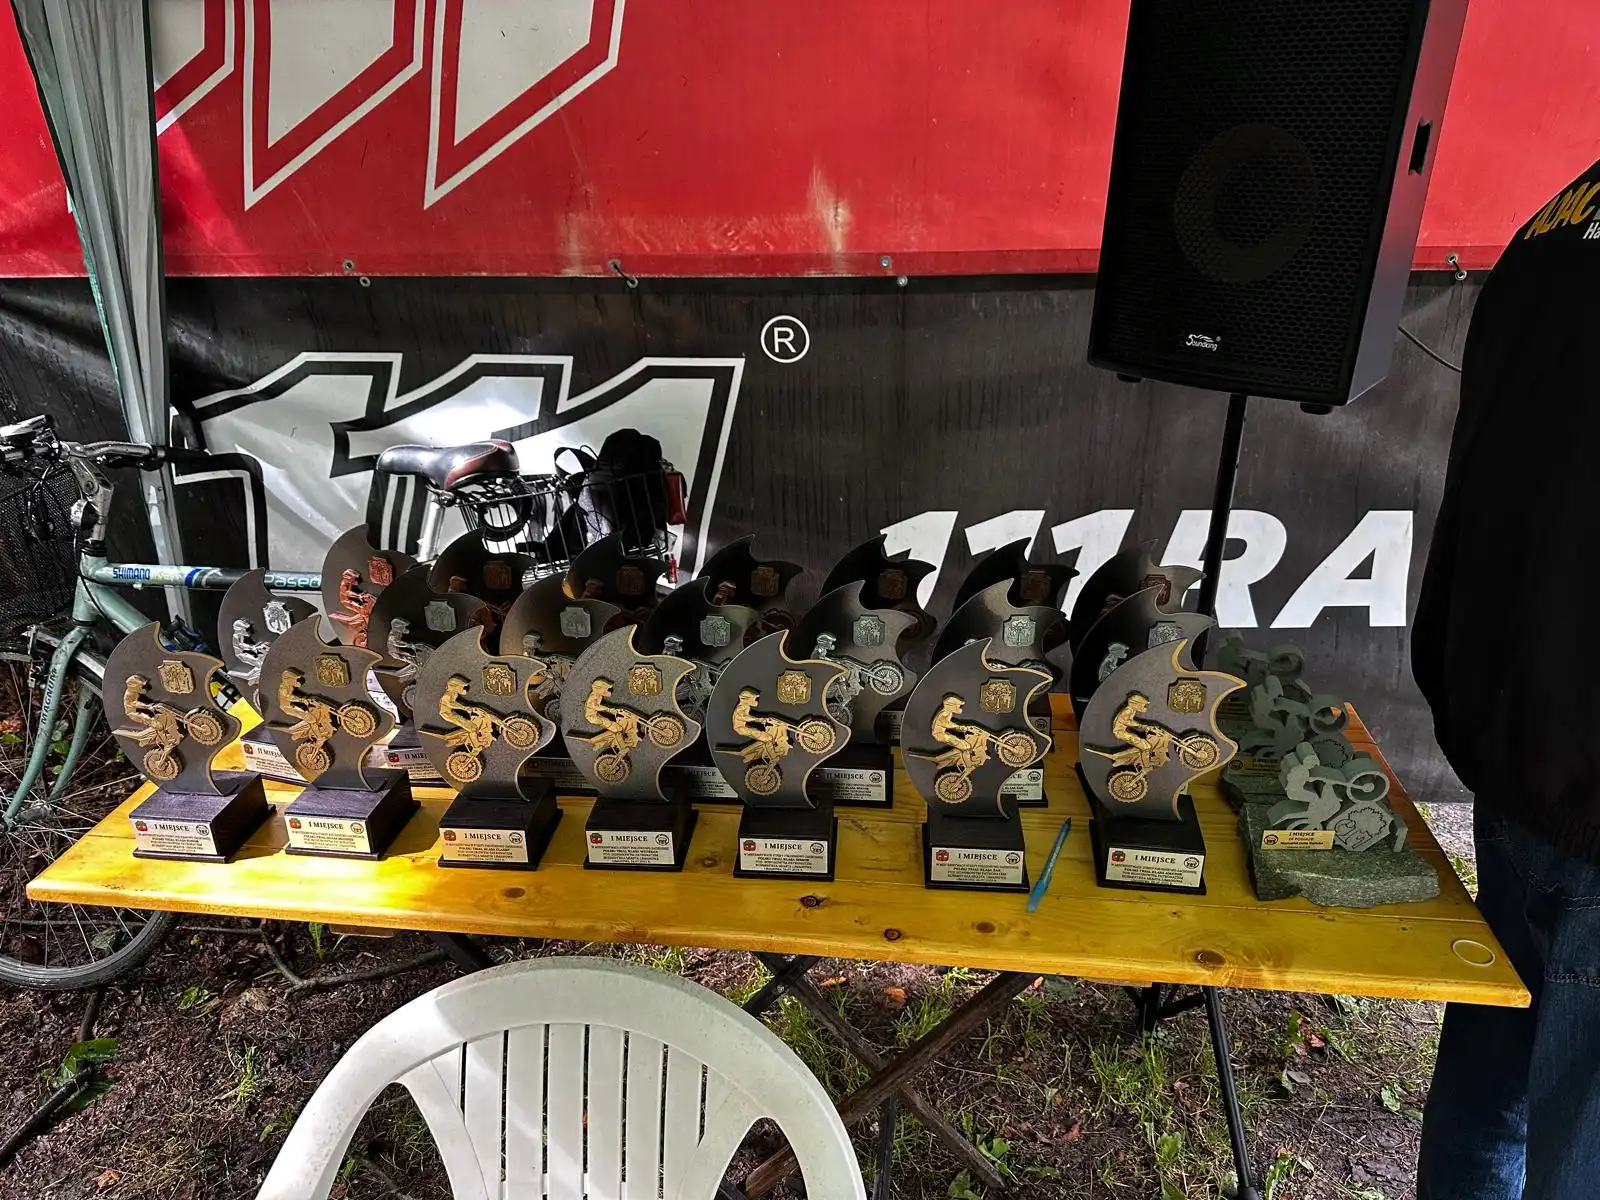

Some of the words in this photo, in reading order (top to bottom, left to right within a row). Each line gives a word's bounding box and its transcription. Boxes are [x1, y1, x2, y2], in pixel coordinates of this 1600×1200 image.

[112, 566, 151, 585] SHIMANO
[262, 570, 321, 589] Paseo
[40, 667, 57, 725] MAGNUM
[834, 772, 864, 780] MIEJSCE
[159, 824, 190, 832] MIEJSCE
[313, 821, 344, 830] MIEJSCE
[469, 832, 502, 840] MIEJSCE
[616, 835, 648, 843] MIEJSCE
[769, 842, 803, 851] MIEJSCE
[963, 853, 998, 861] MIEJSCE
[1139, 855, 1176, 864] MIEJSCE
